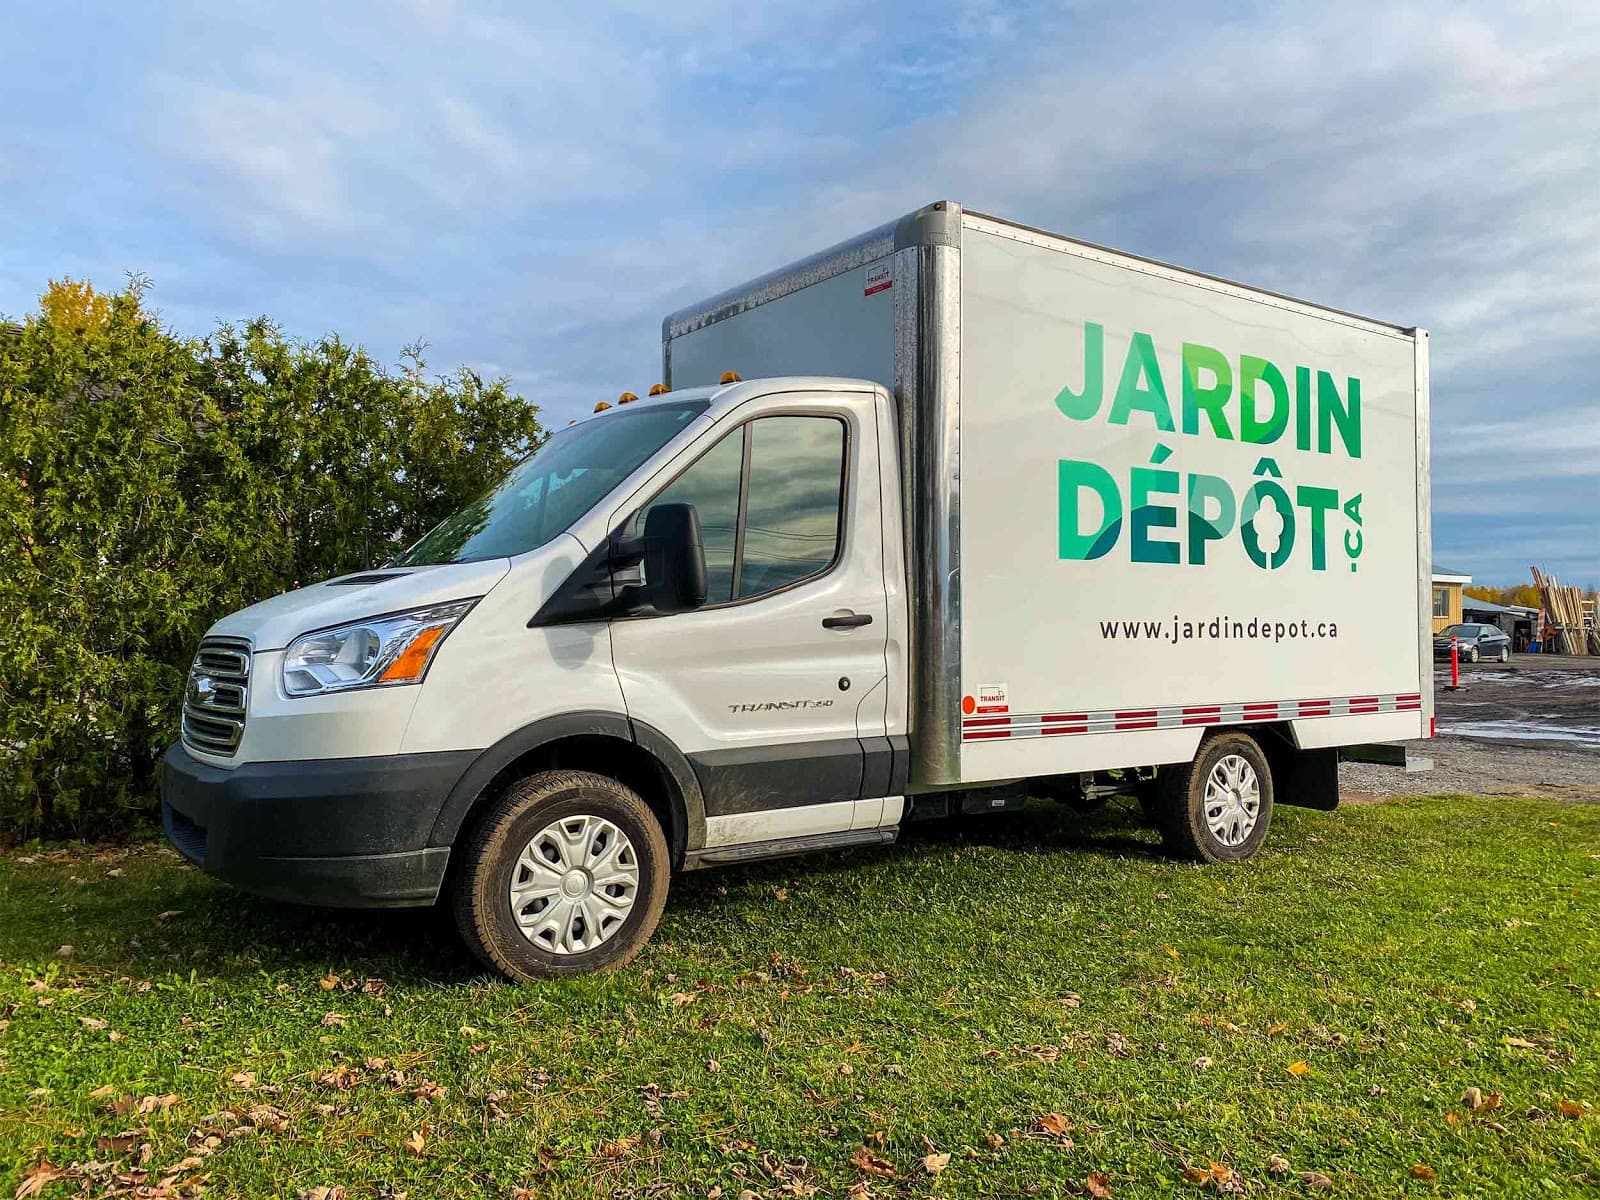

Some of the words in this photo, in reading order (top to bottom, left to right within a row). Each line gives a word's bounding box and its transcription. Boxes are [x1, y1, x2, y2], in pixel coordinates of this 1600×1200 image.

[1053, 321, 1362, 459] JARDIN
[1057, 442, 1339, 571] DÉPÔT
[1099, 615, 1338, 644] www.jardindepot.ca
